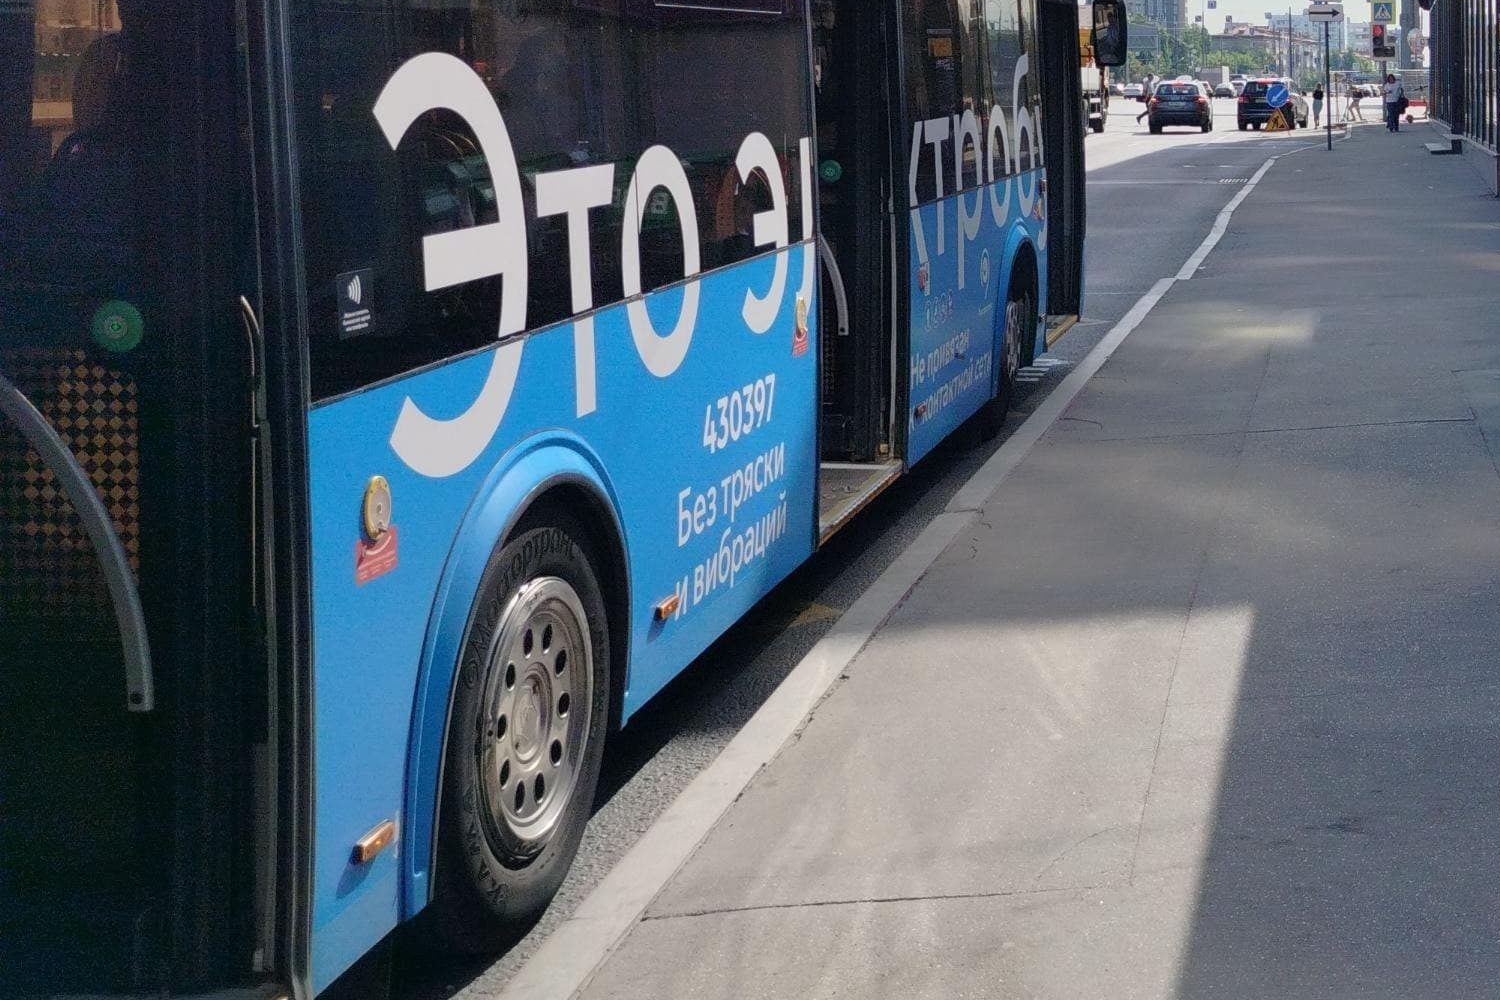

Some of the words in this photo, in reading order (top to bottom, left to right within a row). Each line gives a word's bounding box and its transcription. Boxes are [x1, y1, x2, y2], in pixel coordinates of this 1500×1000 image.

[372, 51, 701, 478] Это
[703, 373, 776, 454] 430397
[677, 486, 717, 548] Без
[721, 441, 785, 523] тряски
[693, 490, 787, 607] вибраций
